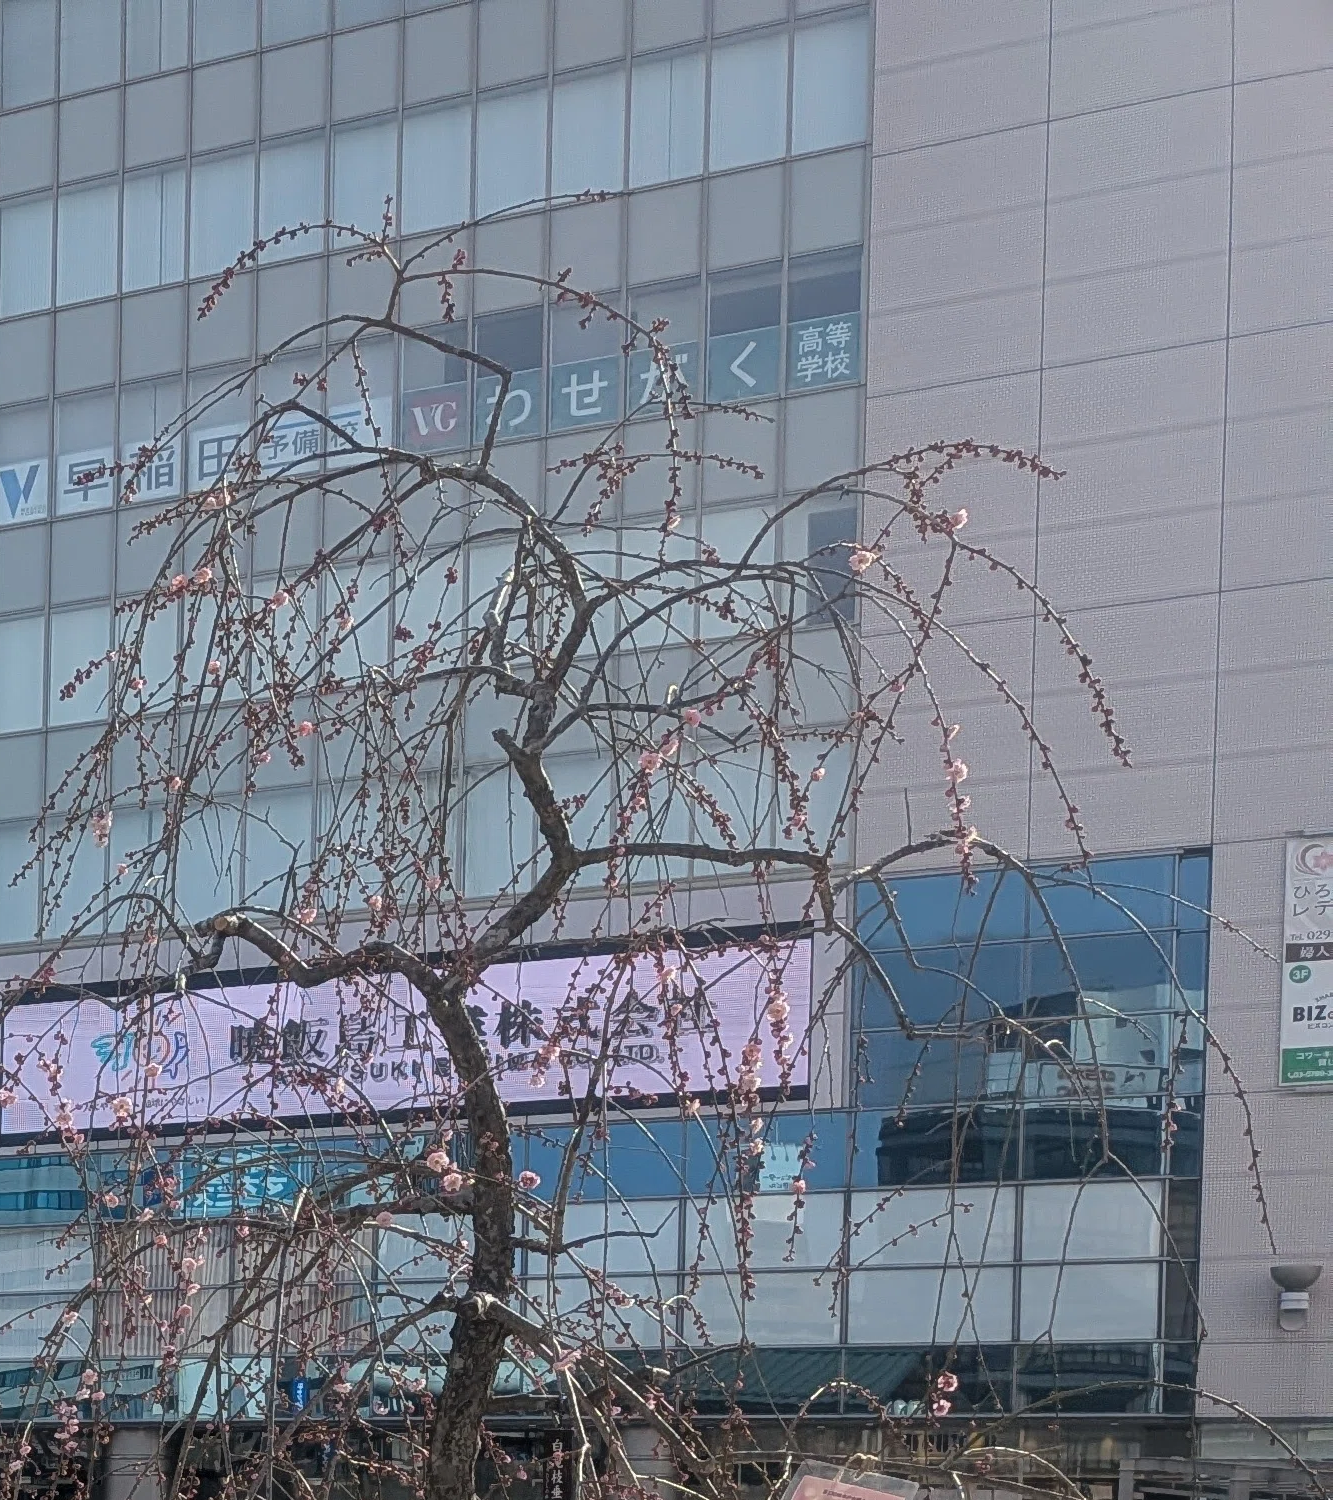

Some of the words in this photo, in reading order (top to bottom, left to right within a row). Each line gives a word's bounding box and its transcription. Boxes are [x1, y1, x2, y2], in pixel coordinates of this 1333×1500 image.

[797, 321, 852, 354] 高等
[796, 349, 851, 383] 学校
[485, 341, 758, 432] わせがく
[410, 401, 458, 436] VG
[1299, 945, 1333, 959] 婦人
[1292, 968, 1310, 981] 3F
[550, 1438, 563, 1500] 白枝垂
